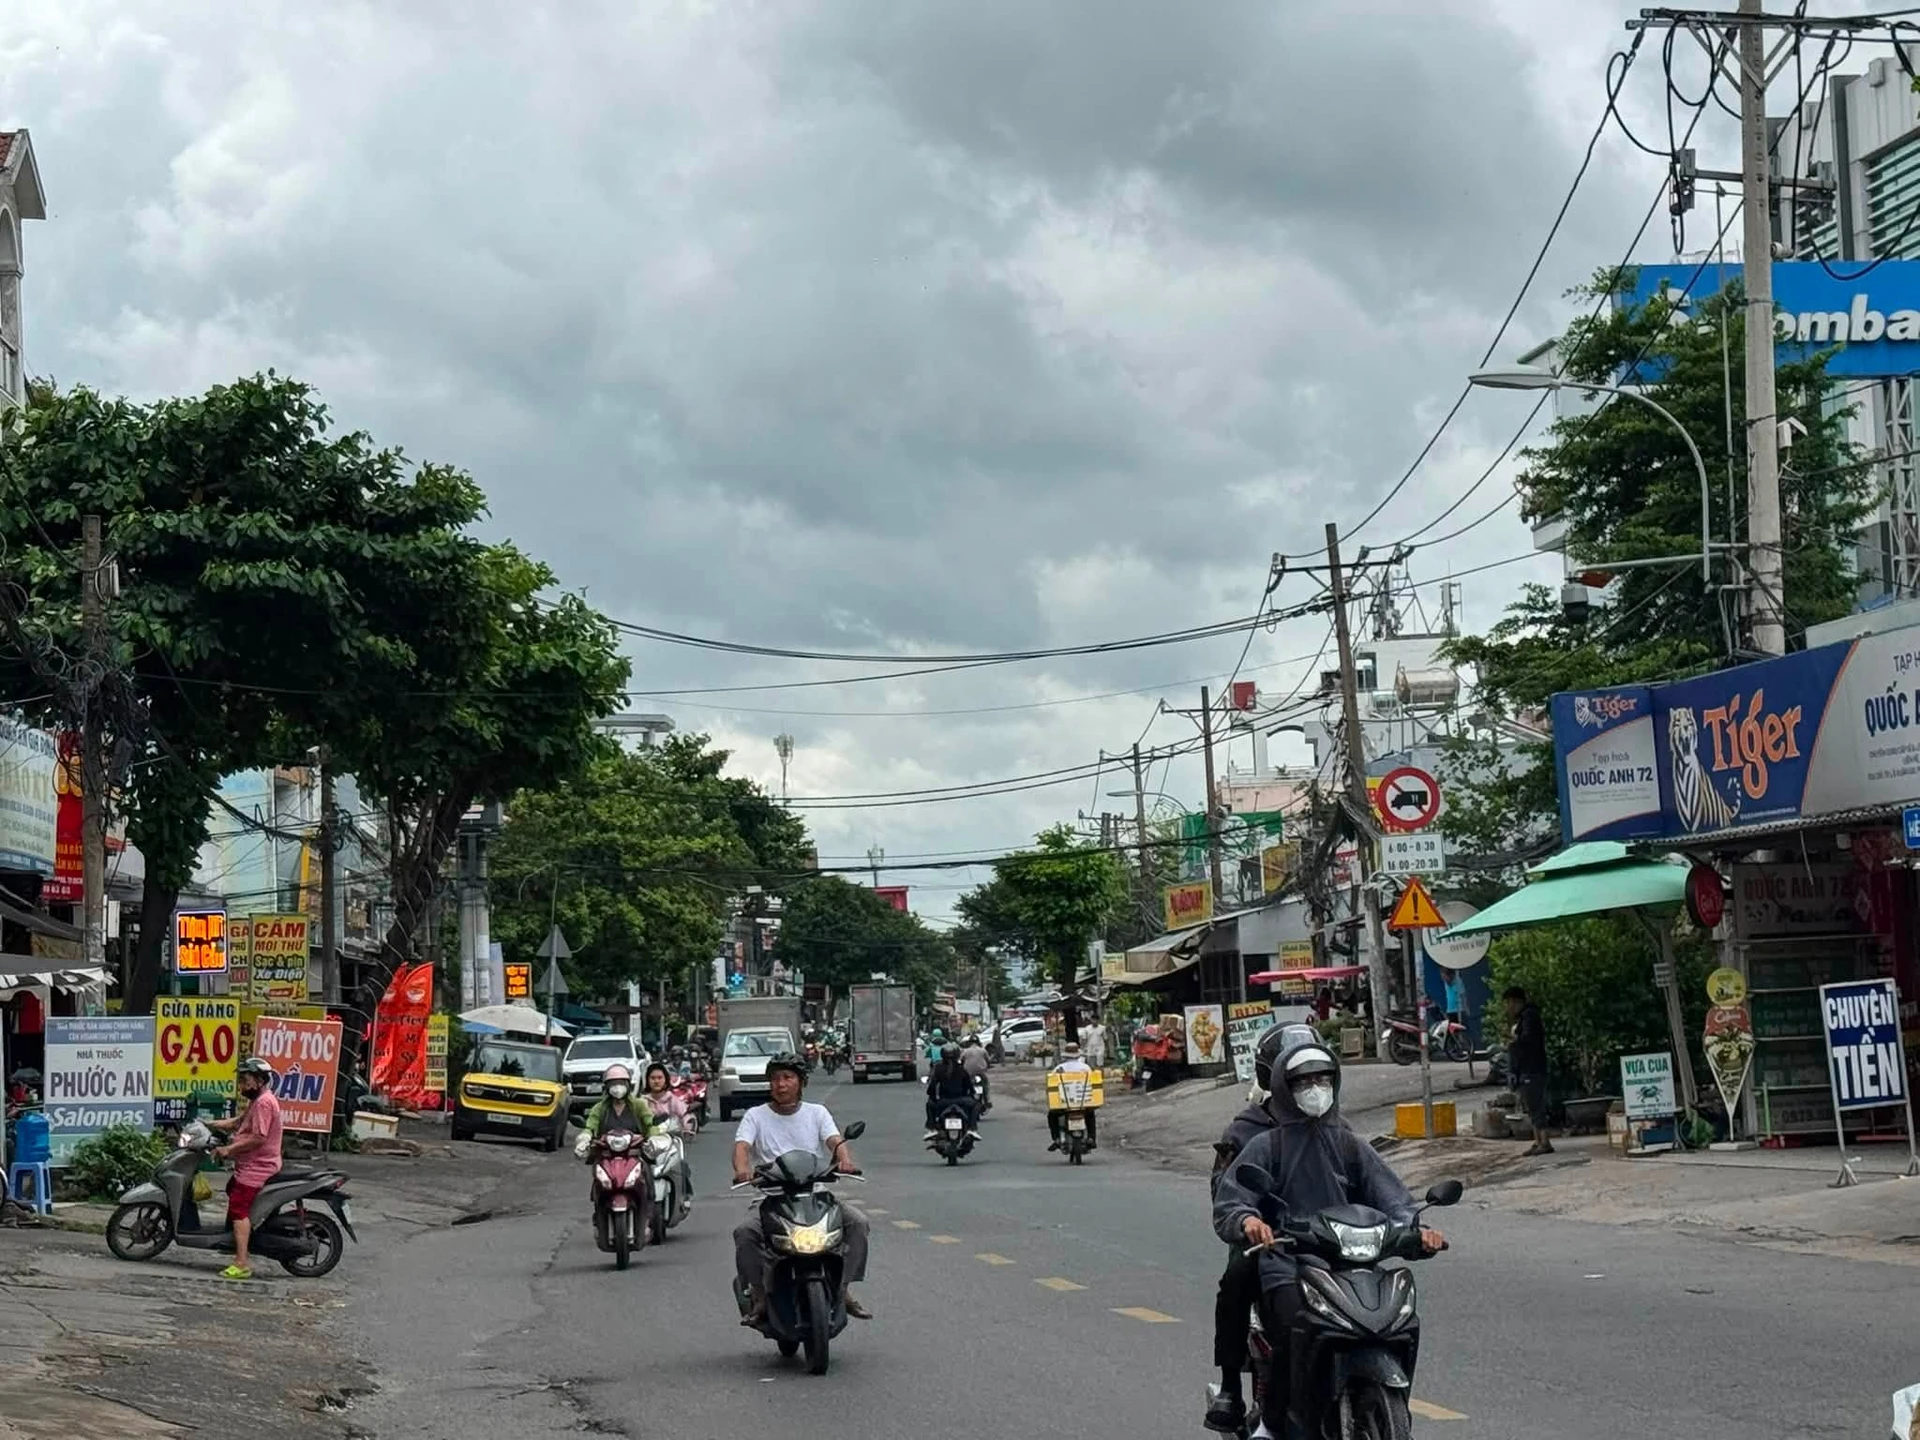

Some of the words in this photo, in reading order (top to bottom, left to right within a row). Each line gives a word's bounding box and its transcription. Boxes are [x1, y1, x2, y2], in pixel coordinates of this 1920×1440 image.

[1592, 693, 1637, 719] Tiger
[1865, 681, 1909, 738] QUỐC
[1703, 688, 1802, 801] Tiger
[1609, 768, 1635, 785] ANH
[1637, 766, 1653, 782] 72
[161, 1023, 235, 1075] GẠO
[258, 1022, 297, 1059] HỚT
[300, 1026, 335, 1061] TÓC
[50, 1064, 117, 1097] PHƯỚC
[123, 1071, 149, 1097] AN
[1648, 1057, 1669, 1074] CUA
[1832, 1027, 1902, 1100] TIỀN
[53, 1107, 145, 1129] Salonpas
